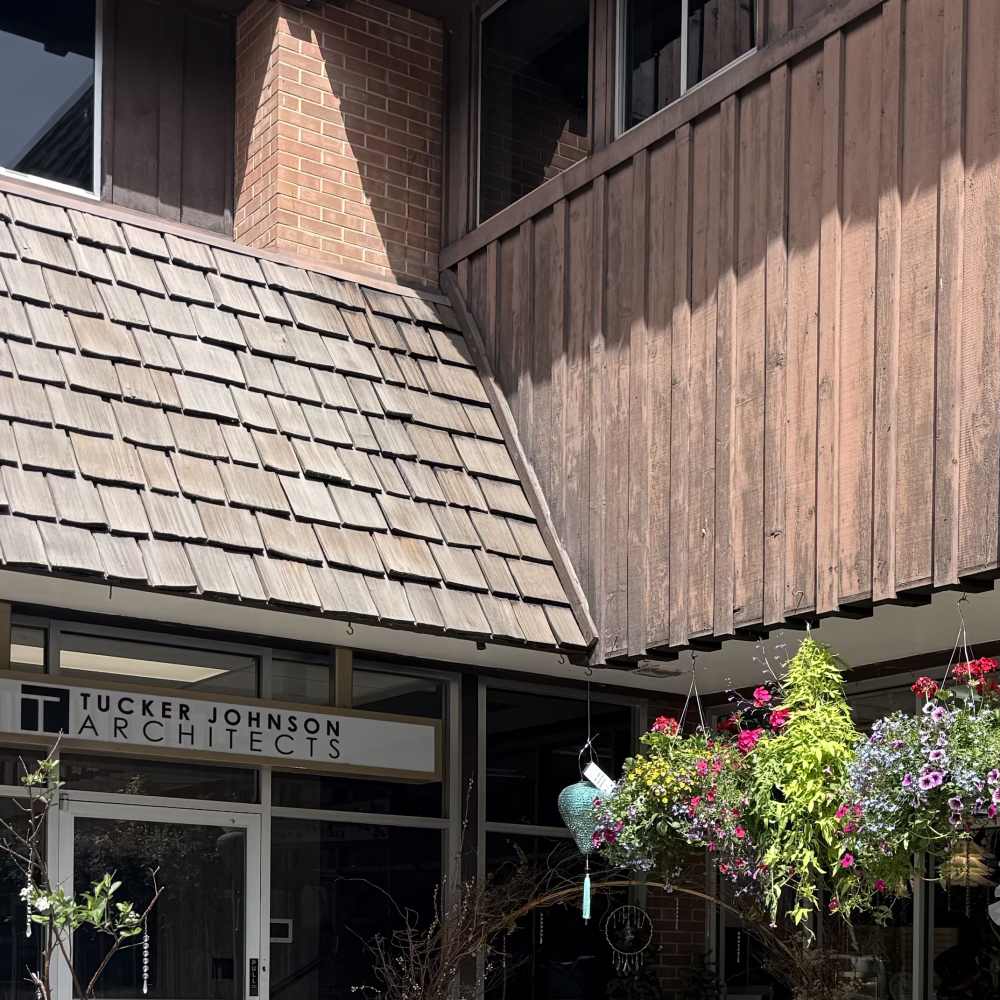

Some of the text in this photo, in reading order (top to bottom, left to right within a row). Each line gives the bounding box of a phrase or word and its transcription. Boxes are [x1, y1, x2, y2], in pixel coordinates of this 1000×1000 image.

[78, 714, 342, 760] ARCHITECTS
[80, 692, 341, 737] TUCKER JOHNSON
